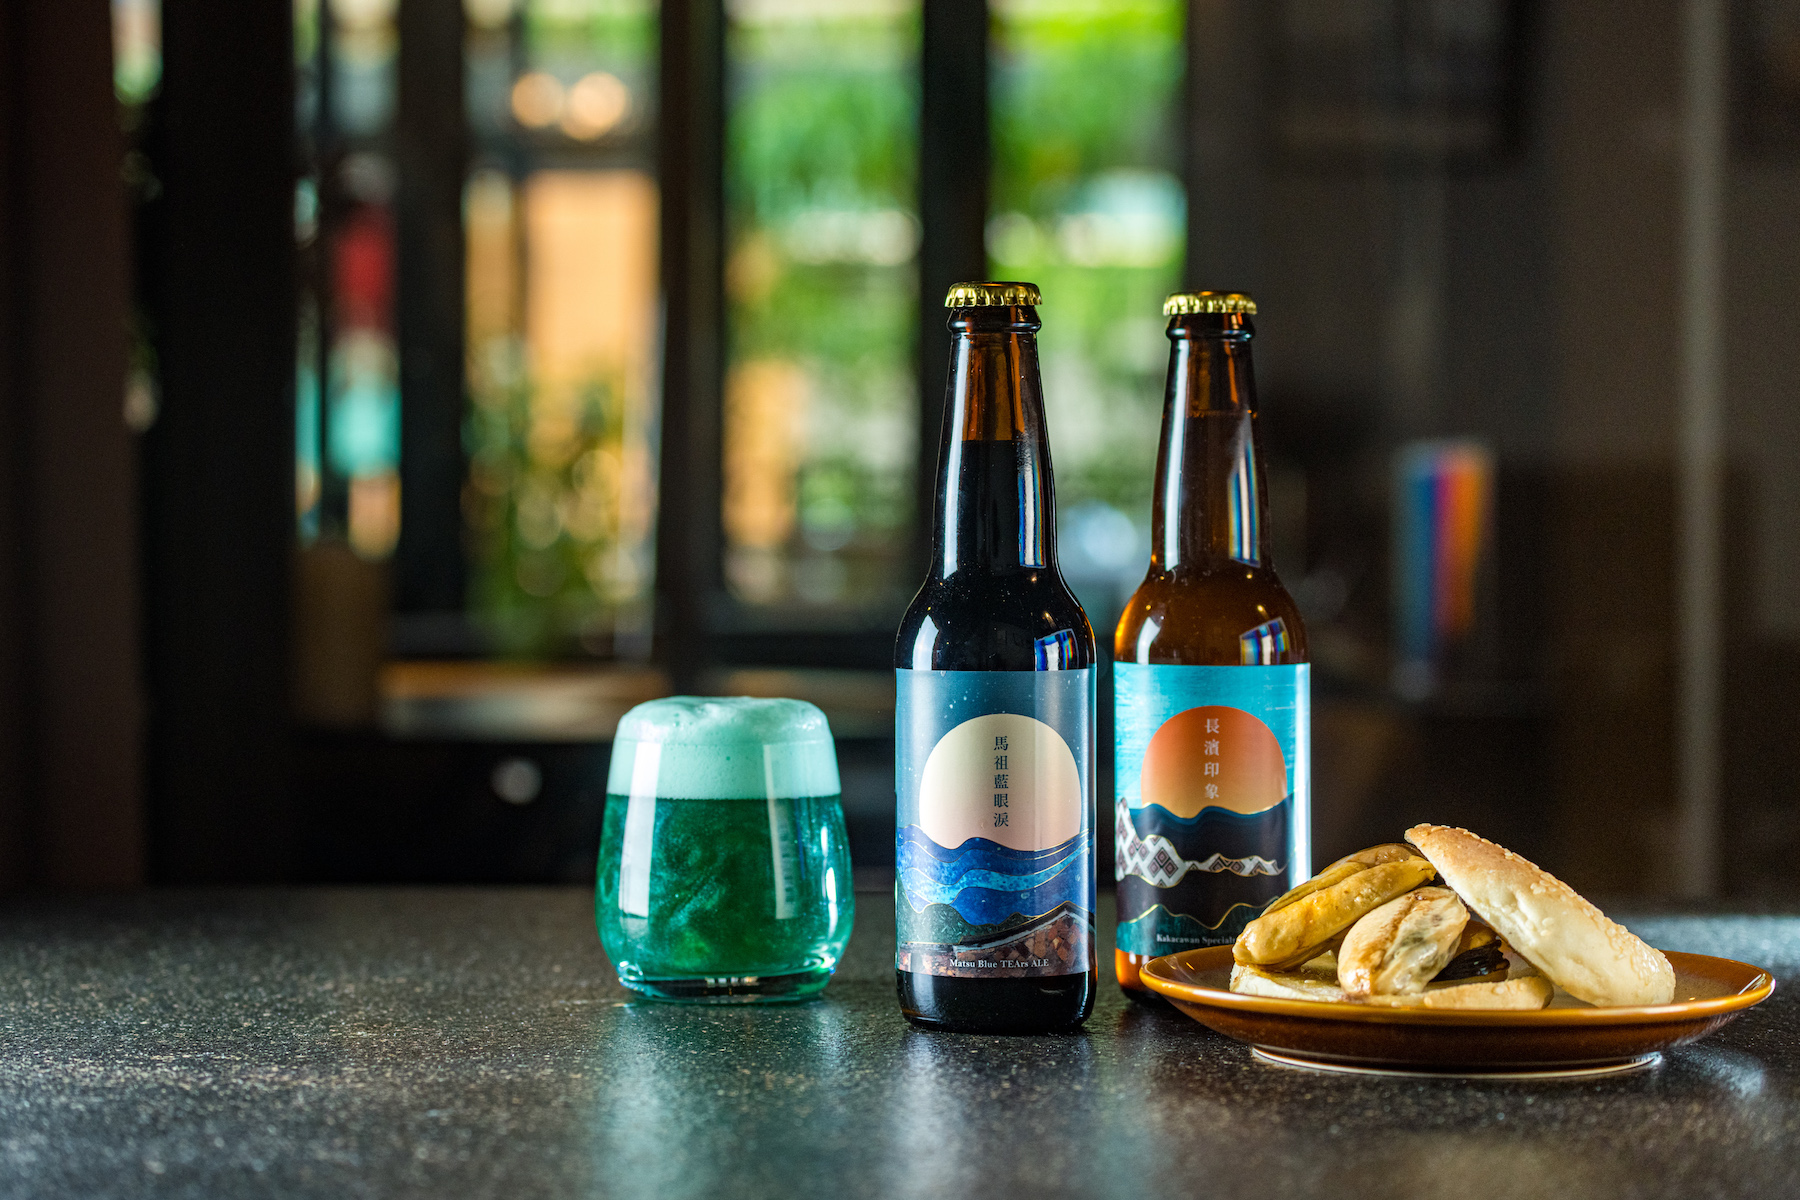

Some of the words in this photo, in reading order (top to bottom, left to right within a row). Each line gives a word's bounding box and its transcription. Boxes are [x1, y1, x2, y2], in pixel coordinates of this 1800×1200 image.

[993, 735, 1009, 828] 馬祖藍眼淚
[1204, 718, 1220, 799] 長濱印象
[949, 959, 976, 968] Matsu
[977, 960, 998, 968] Blue
[1000, 960, 1029, 968] TEArs
[1031, 959, 1049, 967] ALE
